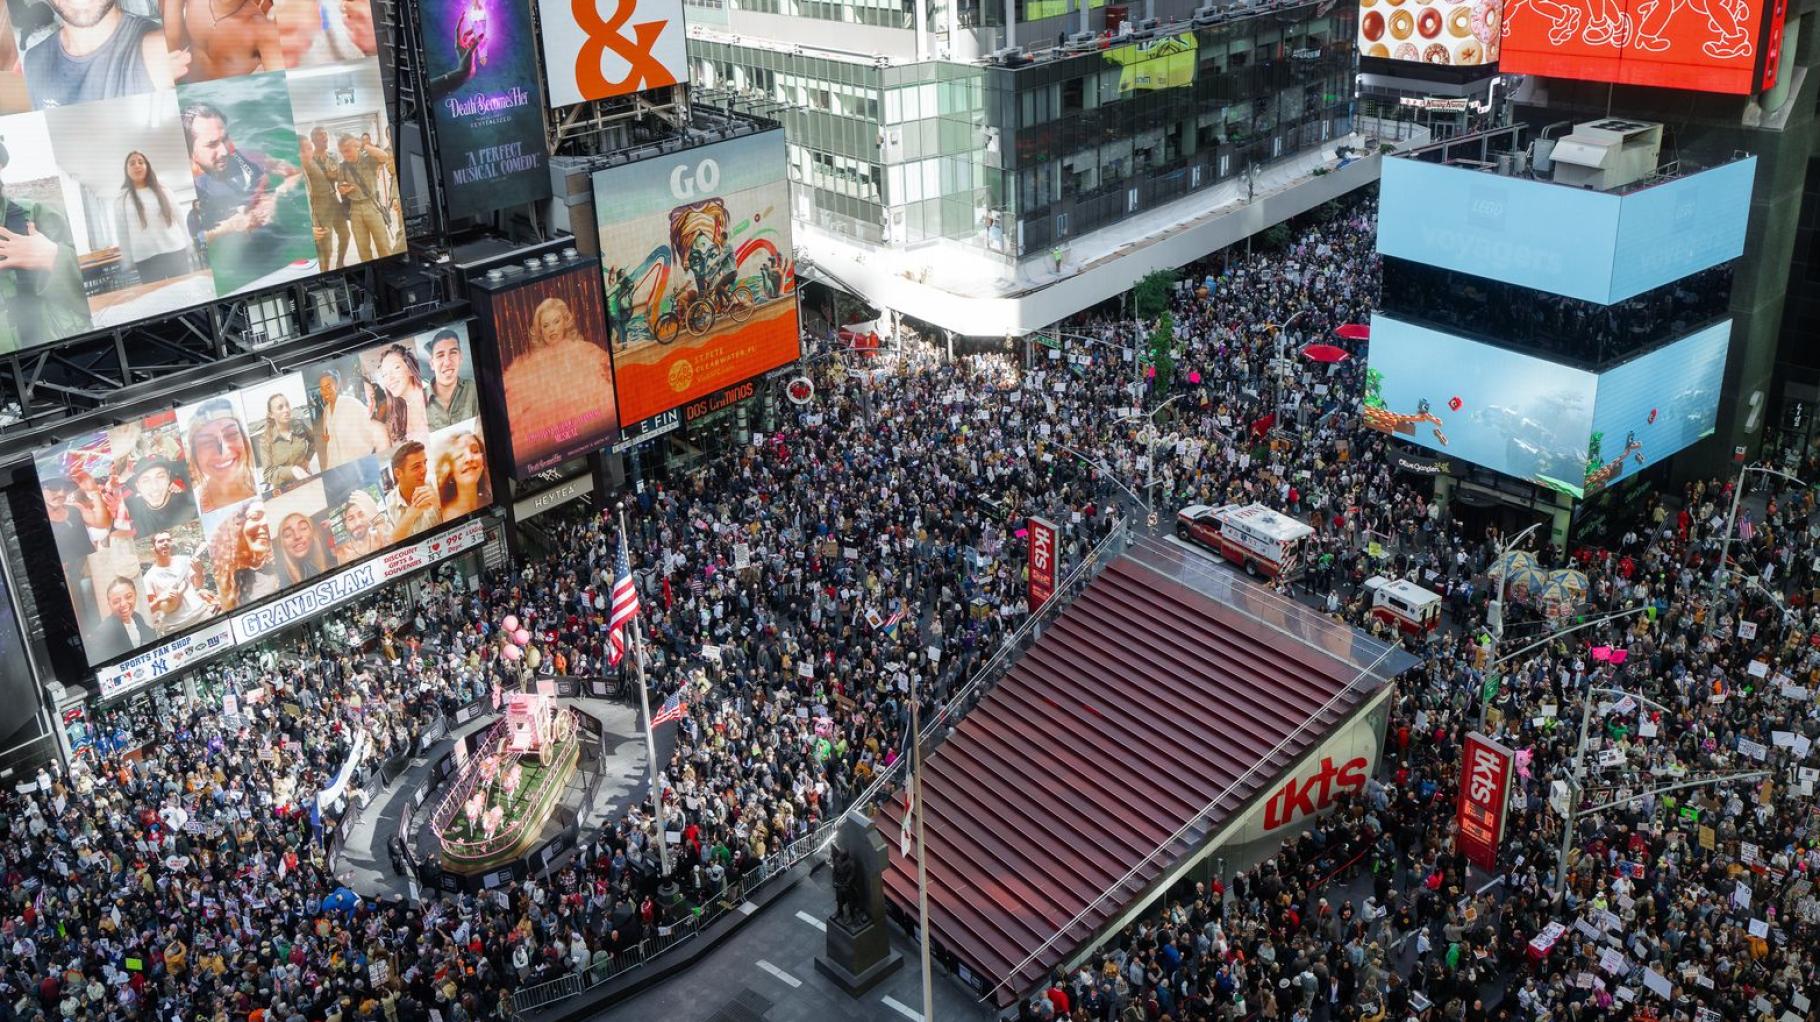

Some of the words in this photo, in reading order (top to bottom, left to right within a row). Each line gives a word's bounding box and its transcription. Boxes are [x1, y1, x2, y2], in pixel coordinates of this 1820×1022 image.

[445, 97, 476, 119] Death
[475, 92, 513, 115] Becomes
[508, 86, 529, 107] Her
[478, 142, 522, 165] PERFECT
[453, 163, 498, 185] MUSICAL
[670, 158, 720, 199] GO
[1470, 199, 1504, 218] LEGO
[687, 404, 708, 421] DOS
[534, 485, 575, 509] HEYTEA
[383, 547, 418, 564] DISCOUNT
[1034, 526, 1051, 570] tkts
[388, 558, 408, 570] GIFTS
[119, 653, 152, 672] SPORTS
[153, 646, 170, 660] FAN
[171, 636, 192, 652] SHOP
[1470, 748, 1501, 804] tkts
[1264, 756, 1368, 831] tkts
